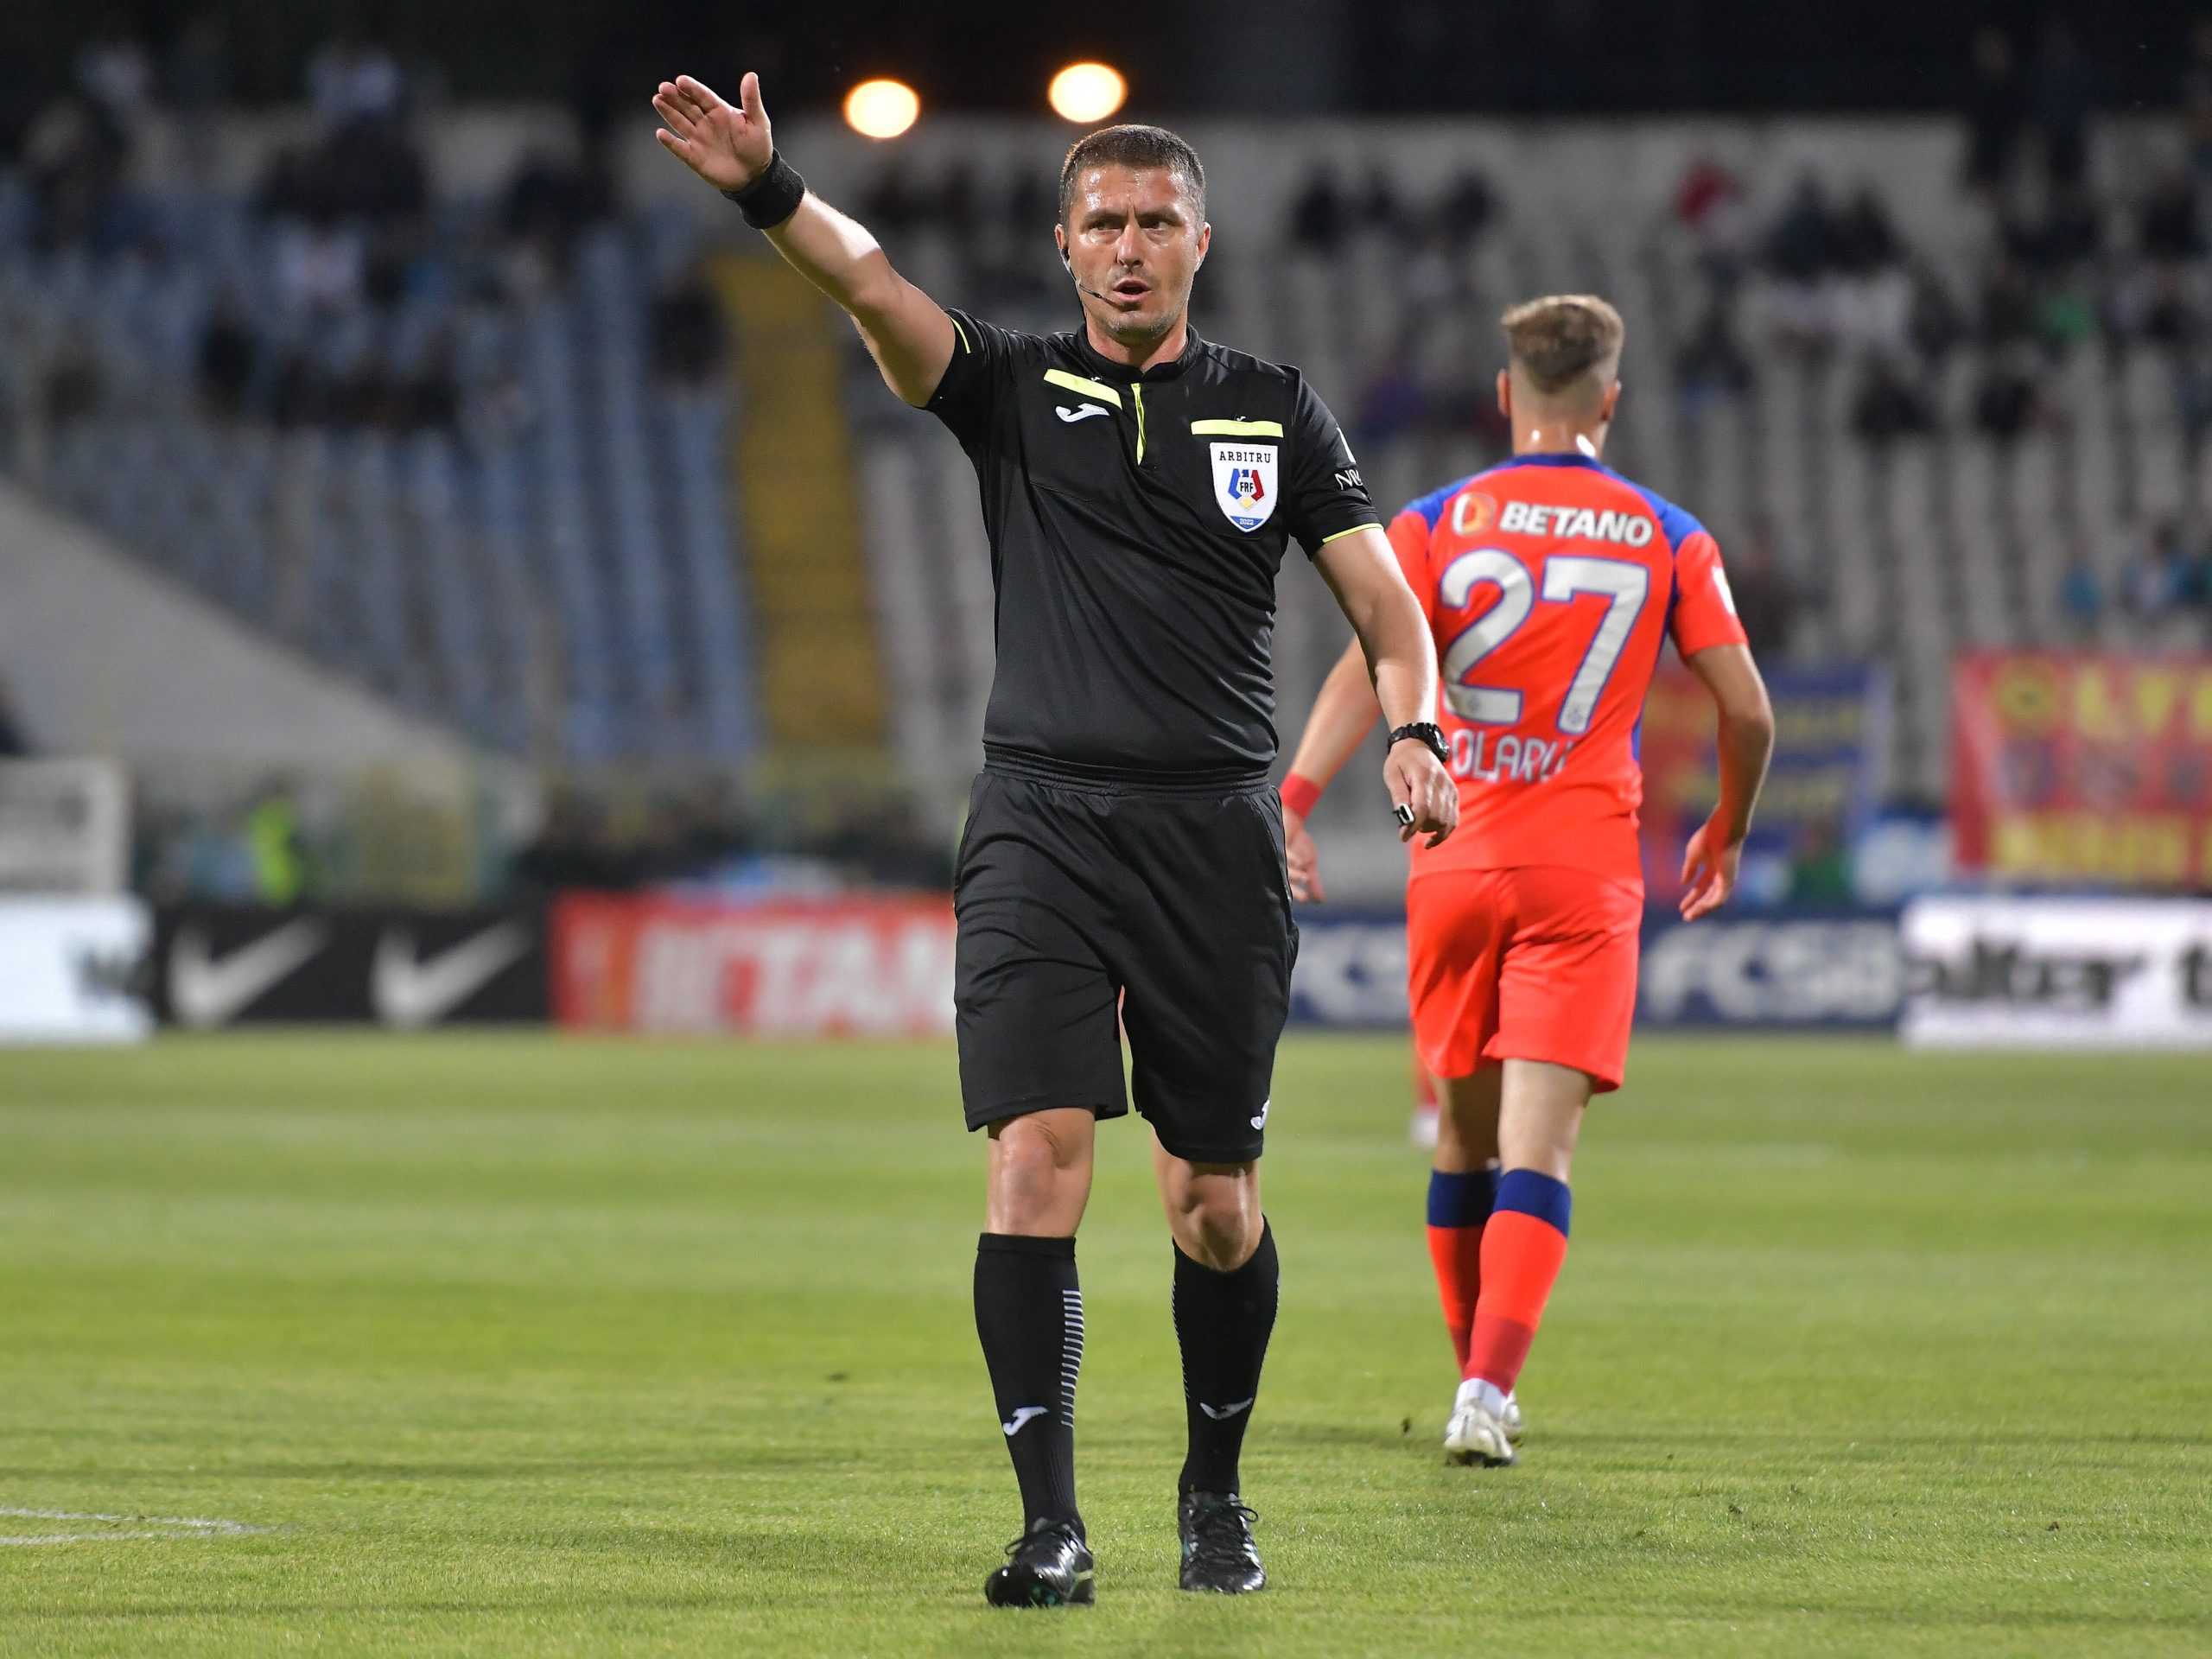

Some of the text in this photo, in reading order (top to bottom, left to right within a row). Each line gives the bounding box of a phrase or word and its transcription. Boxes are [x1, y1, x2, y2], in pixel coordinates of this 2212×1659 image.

[1219, 451, 1271, 464] ARBITRU
[1239, 481, 1254, 493] FRF
[1498, 500, 1653, 548] BETANO
[1440, 547, 1650, 734] 27
